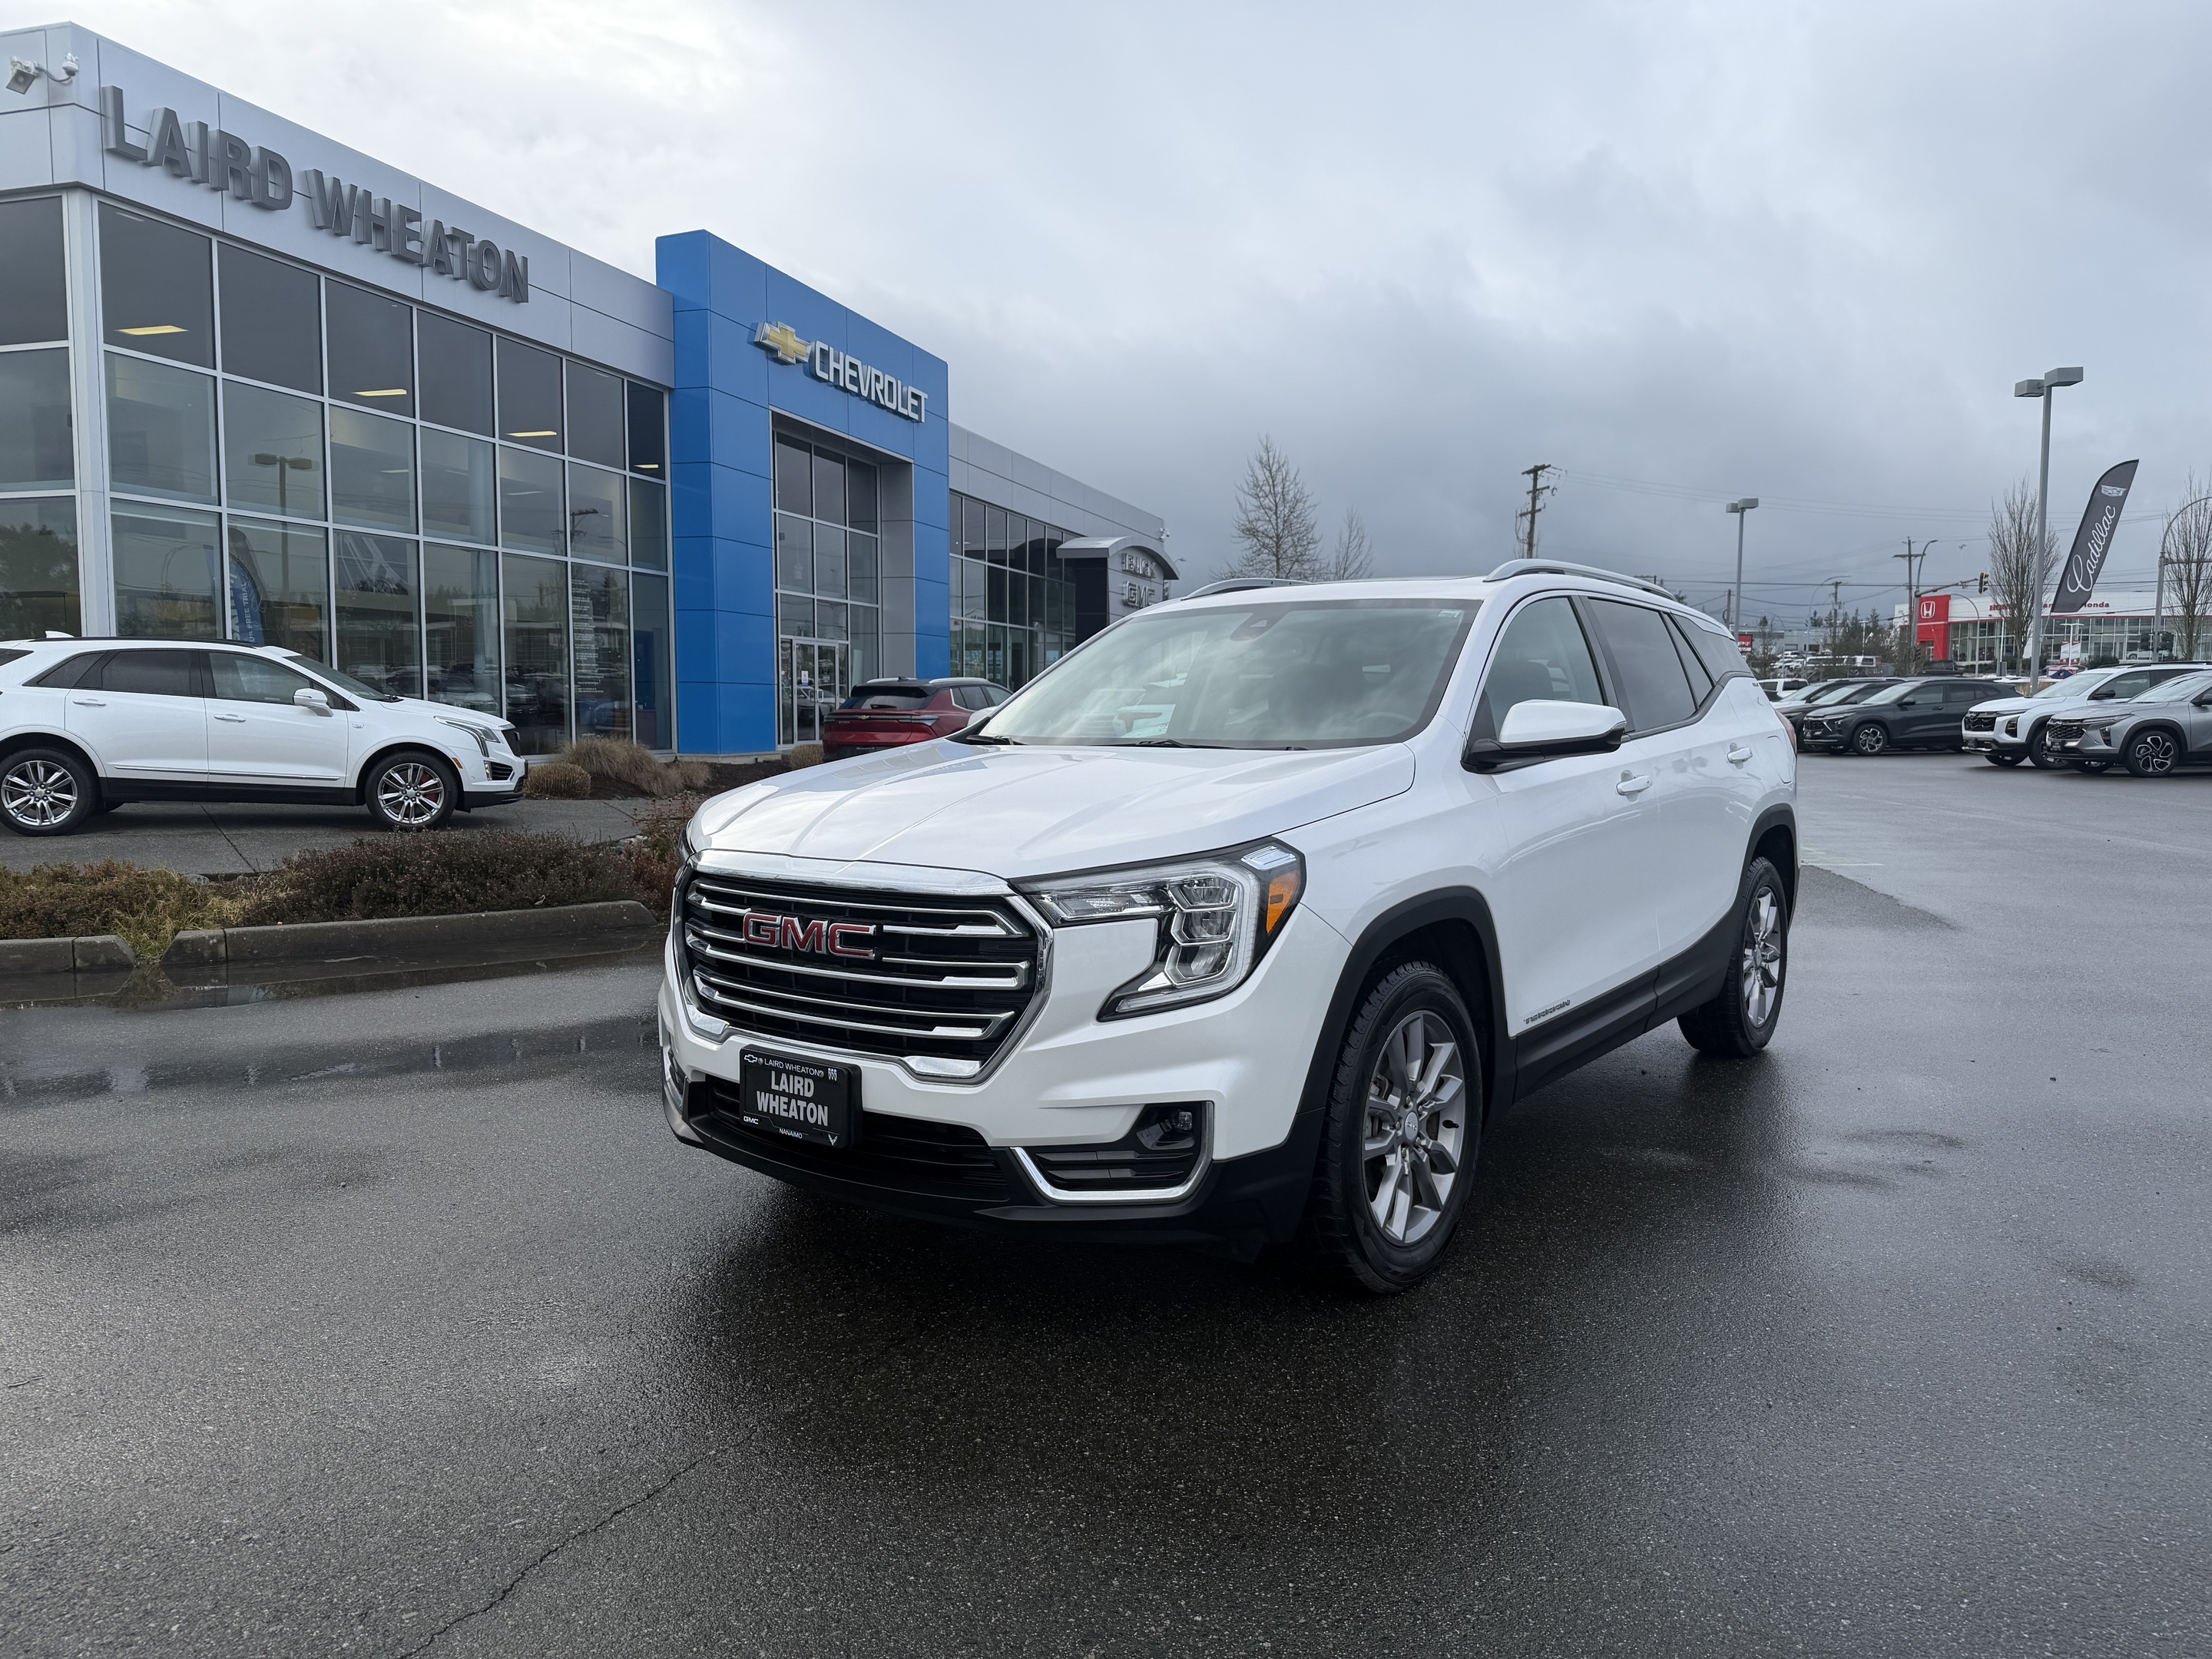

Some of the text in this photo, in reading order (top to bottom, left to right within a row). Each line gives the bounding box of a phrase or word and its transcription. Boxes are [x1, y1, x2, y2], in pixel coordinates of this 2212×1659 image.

[102, 85, 528, 303] LAIRD WHEATON
[813, 340, 928, 423] CHEVROLET
[2067, 505, 2115, 593] Cadillac
[241, 581, 250, 606] TRIAL
[1125, 581, 1155, 608] GMC
[243, 608, 253, 629] FREE
[743, 912, 877, 960] GMC
[1523, 999, 1571, 1025] TERRAIN
[764, 1058, 820, 1077] LAIRD WHEATON
[756, 1070, 828, 1127] LAIRD WHEATON
[743, 1115, 760, 1125] GMC
[779, 1128, 803, 1139] NANAIMO
